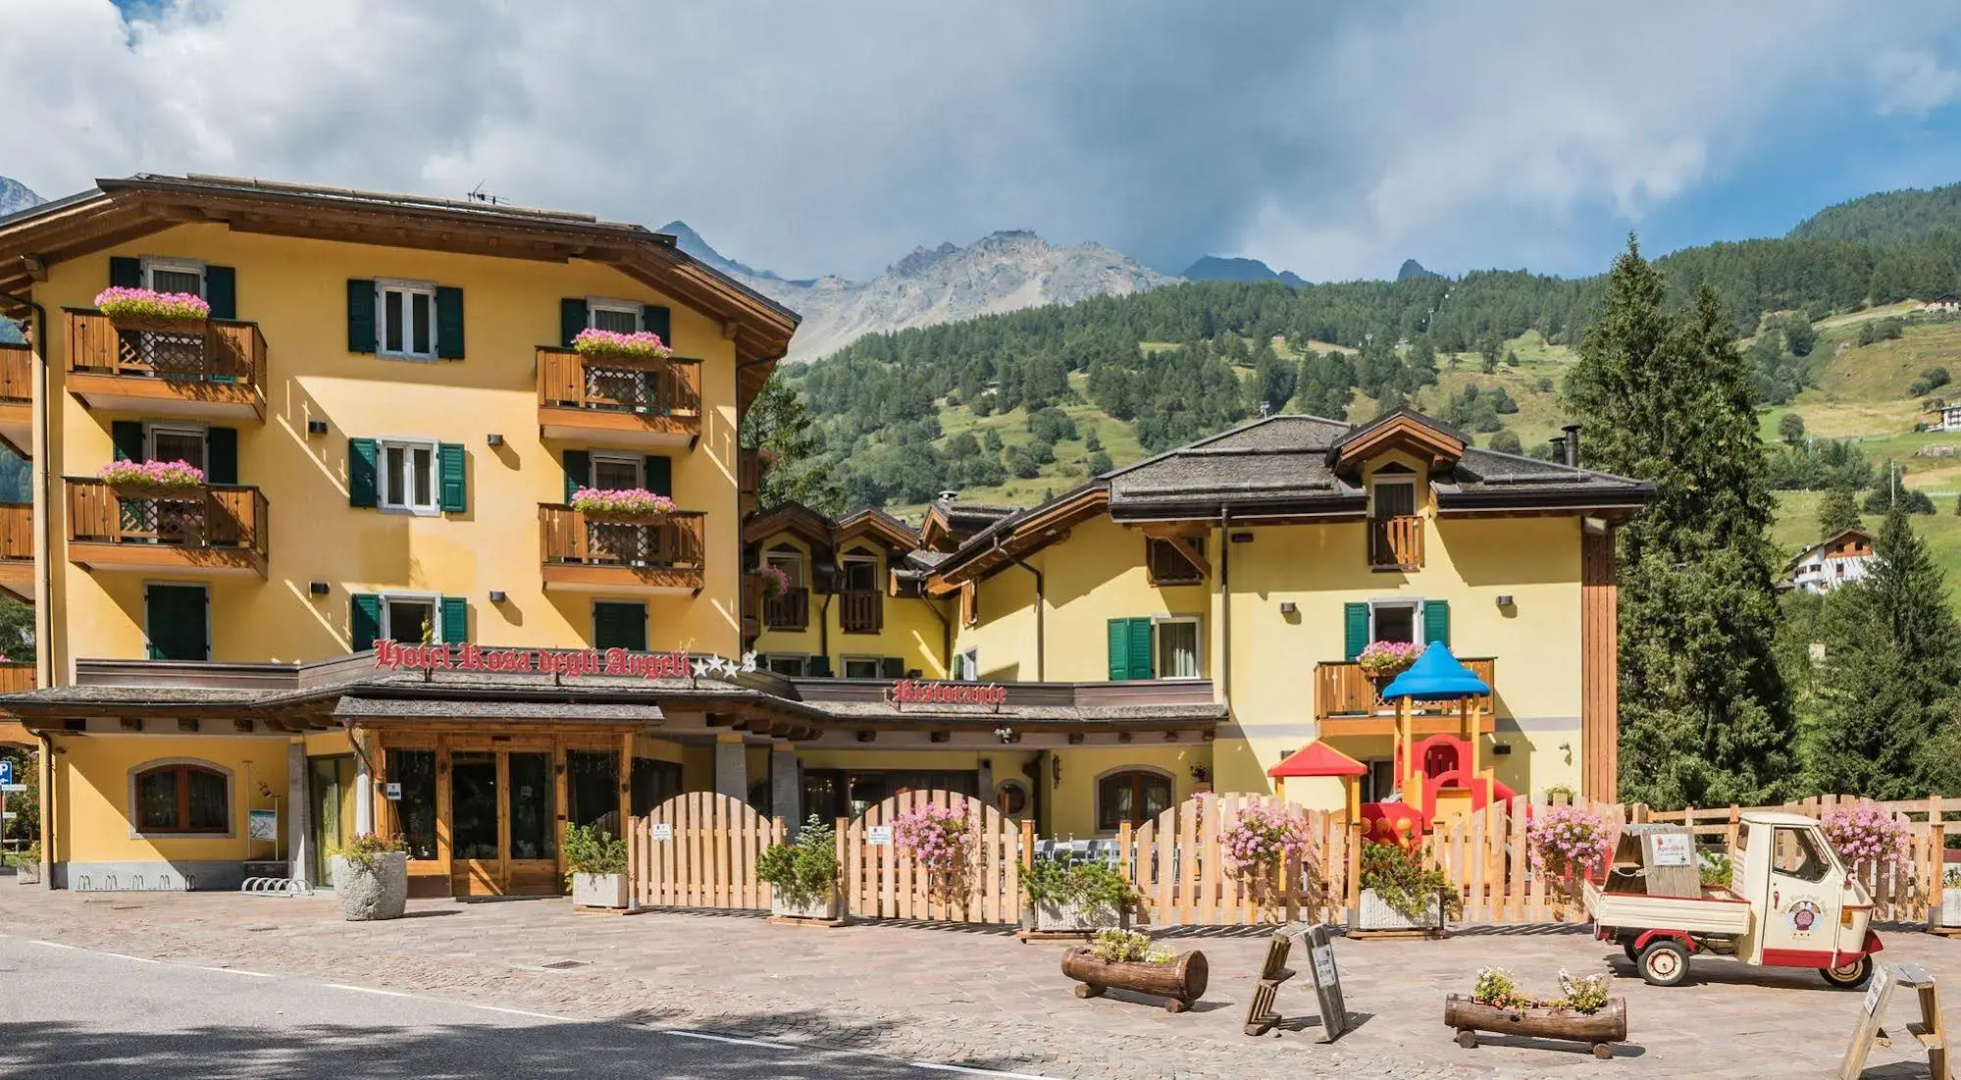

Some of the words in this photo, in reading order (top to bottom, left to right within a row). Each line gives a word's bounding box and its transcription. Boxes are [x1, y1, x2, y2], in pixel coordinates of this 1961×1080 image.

[373, 639, 452, 671] Hotel
[457, 642, 531, 672] Rosa
[538, 648, 600, 678] degli
[604, 647, 691, 679] Angeli
[892, 680, 1007, 703] Ristorante
[0, 763, 8, 775] P
